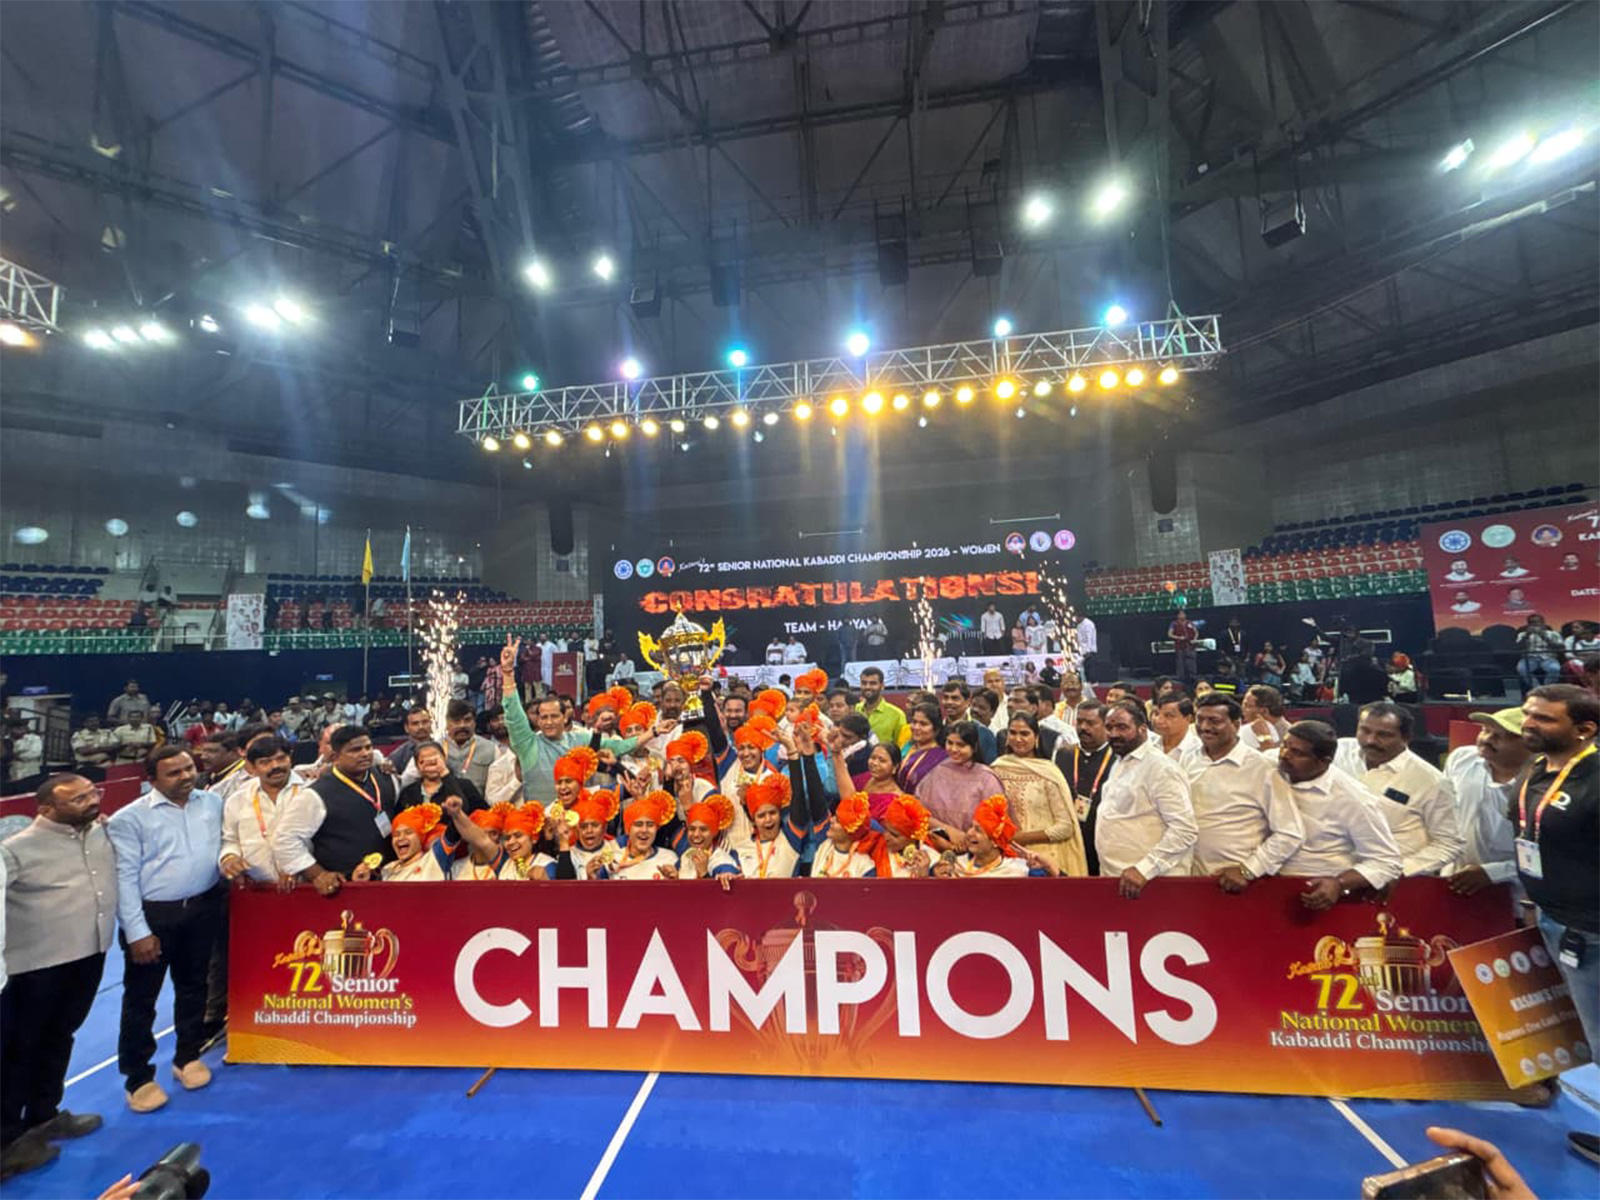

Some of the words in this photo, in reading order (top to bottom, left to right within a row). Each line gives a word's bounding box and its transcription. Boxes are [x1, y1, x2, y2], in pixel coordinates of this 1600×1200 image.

[717, 561, 751, 572] SENIOR
[753, 558, 801, 571] NATIONAL
[803, 554, 845, 567] KABADDI
[847, 550, 922, 563] CHAMPIONSHIP
[924, 548, 950, 559] 2026
[960, 543, 1001, 555] WOMEN
[784, 621, 817, 634] TEAM
[331, 972, 399, 993] Senior
[453, 926, 1219, 1046] CHAMPIONS
[263, 993, 332, 1010] National
[338, 993, 413, 1010] Women's
[1376, 988, 1469, 1013] Senior
[254, 1010, 310, 1025] Kabaddi
[313, 1010, 417, 1028] Championship
[1281, 1011, 1381, 1032] National
[1385, 1014, 1480, 1034] Women
[1270, 1031, 1351, 1049] Kabaddi
[1356, 1032, 1488, 1055] Championsh
